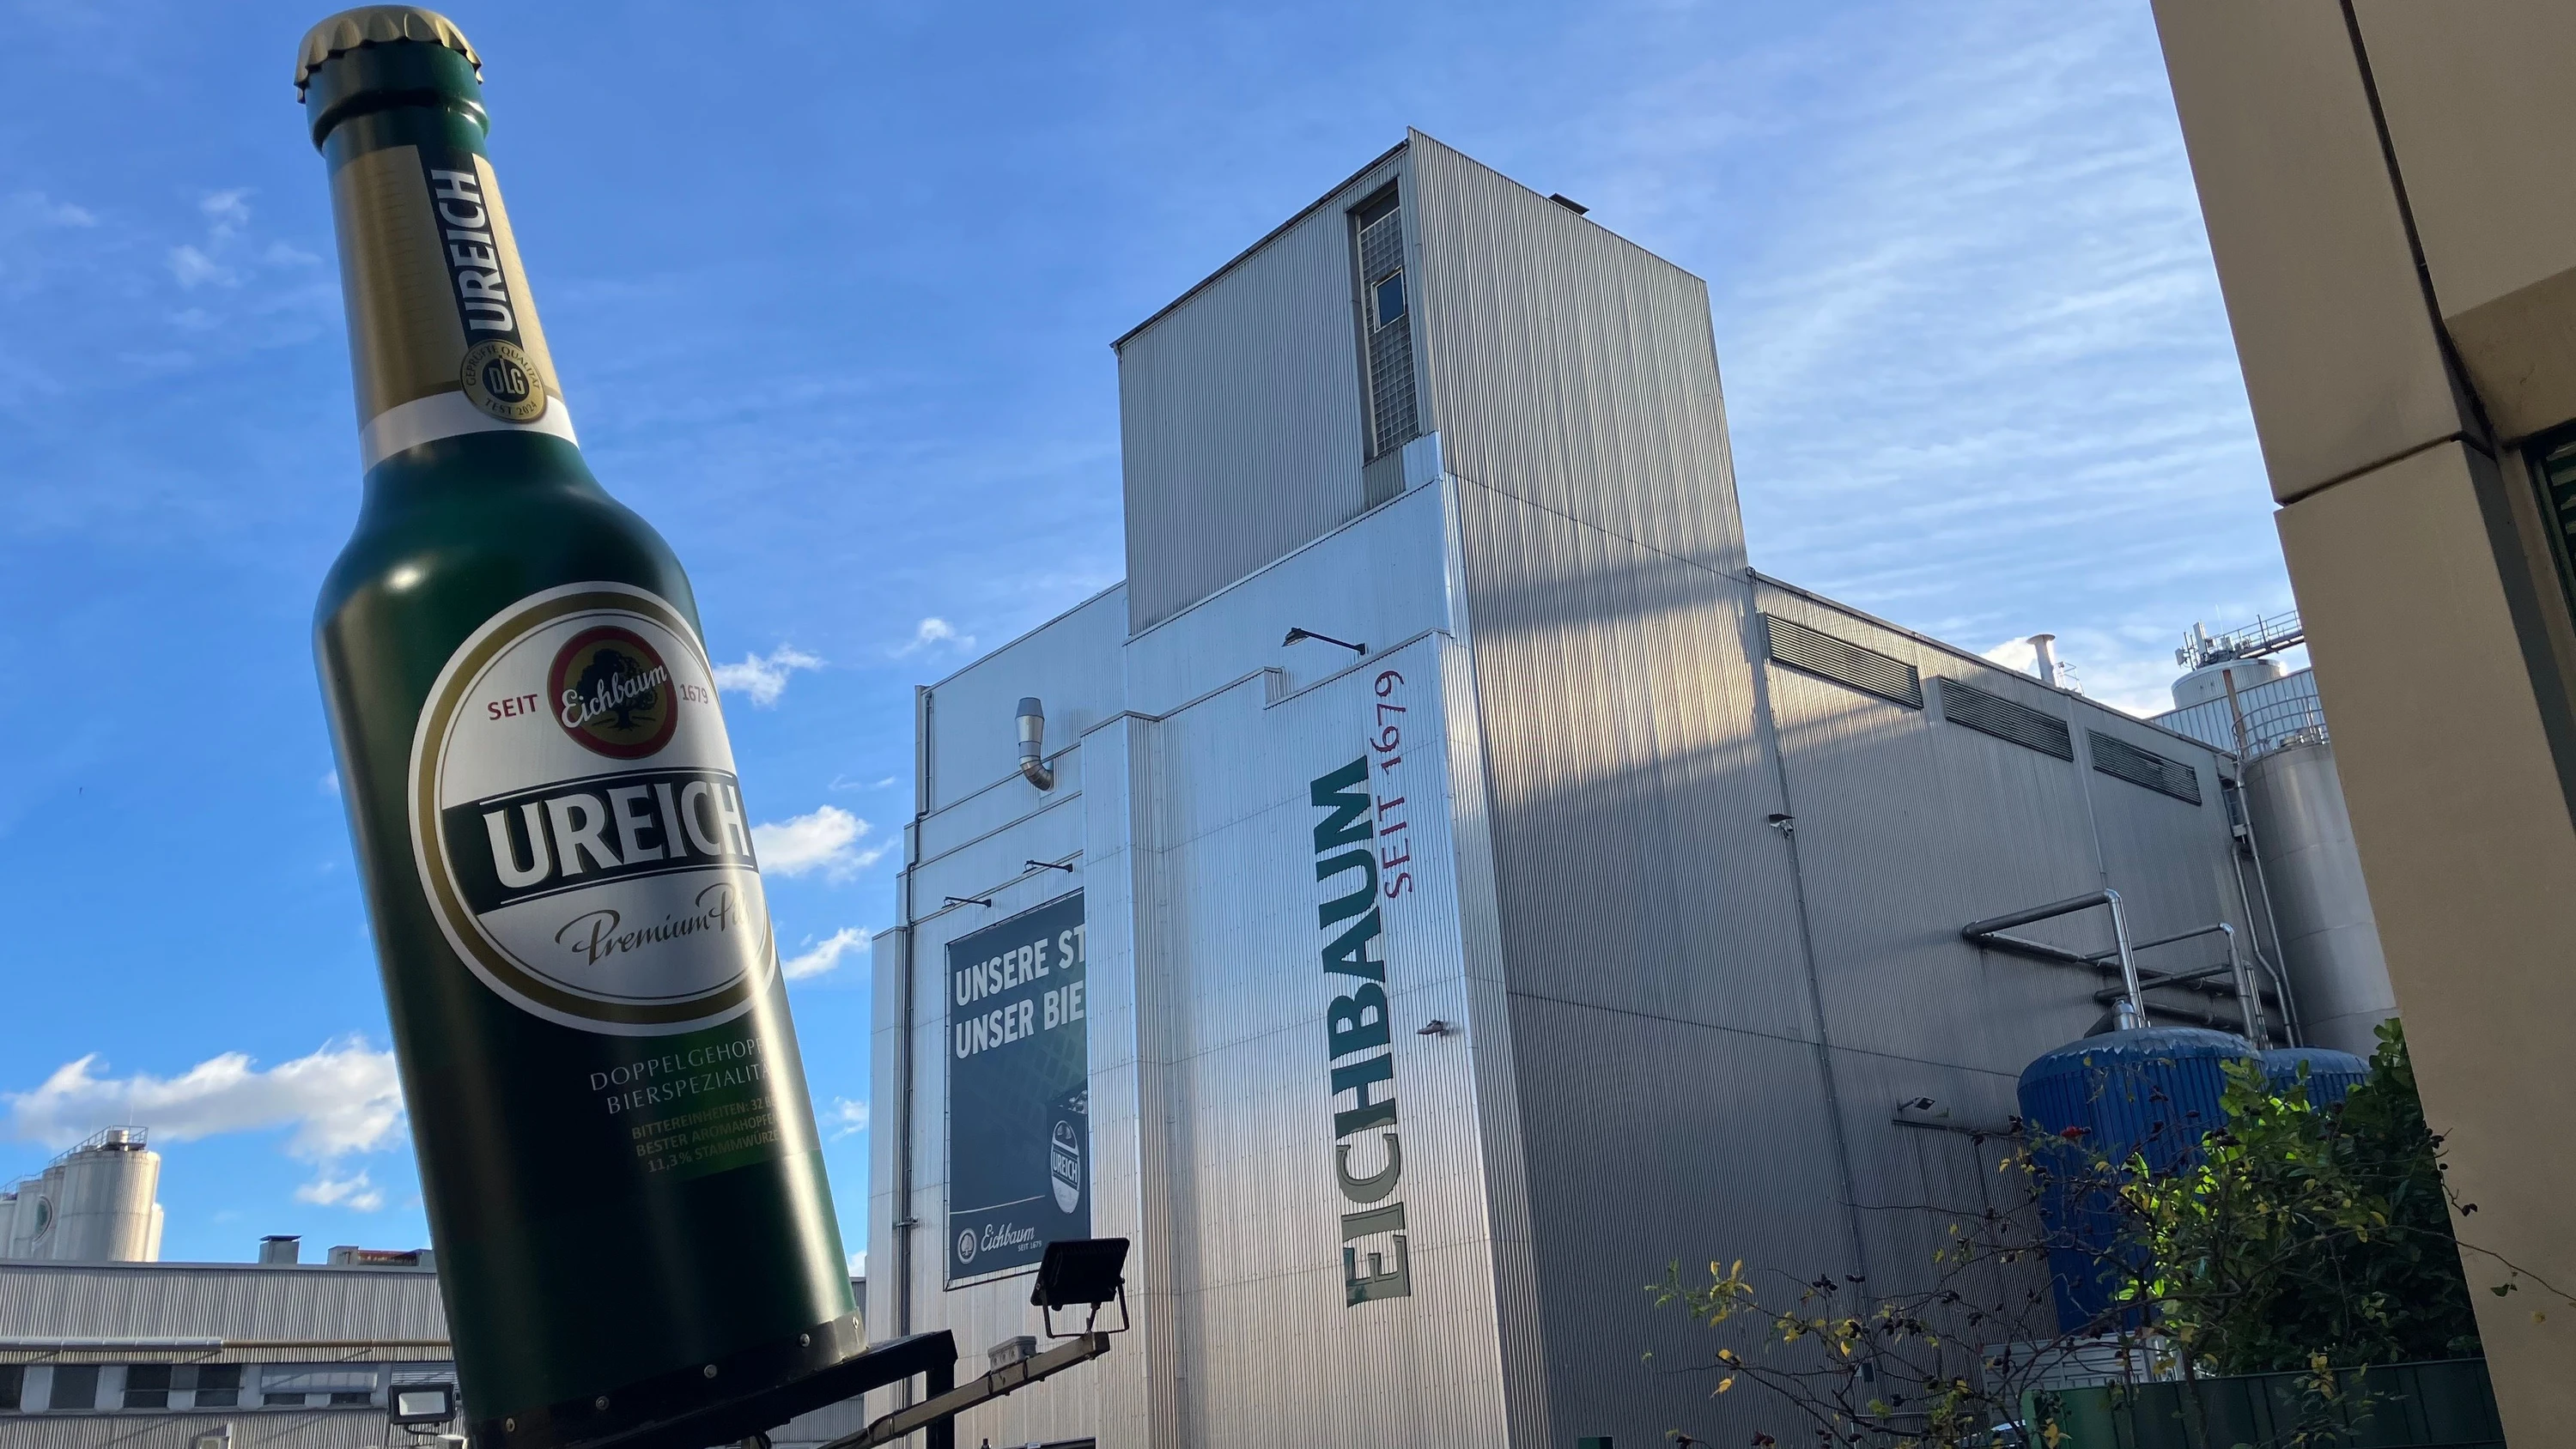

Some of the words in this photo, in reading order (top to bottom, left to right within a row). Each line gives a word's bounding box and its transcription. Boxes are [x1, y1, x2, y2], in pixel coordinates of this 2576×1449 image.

[431, 169, 513, 333] UREICH
[488, 355, 526, 395] DLG
[485, 397, 513, 415] TEST
[516, 401, 538, 415] 2024
[487, 694, 539, 721] SEIT
[680, 683, 708, 704] 1679
[561, 664, 667, 729] Eichbaum
[1370, 670, 1406, 774] 1679
[483, 778, 751, 888] UREICH
[1379, 794, 1413, 899] SEIT
[555, 909, 710, 967] Premium
[956, 938, 1050, 1006] UNSERE
[956, 998, 1035, 1058] UNSER
[1044, 980, 1084, 1032] BIE
[1310, 755, 1412, 1308] EICHBAUM
[590, 1037, 766, 1091] DOPPELGEHOPF
[607, 1058, 773, 1114] BIERSPEZIALITÄ
[635, 1134, 688, 1157] BESTER
[1053, 1151, 1078, 1183] UREICH
[981, 1222, 1035, 1252] Eichbaum
[1018, 1242, 1029, 1252] SEIT
[1030, 1240, 1042, 1250] 1679
